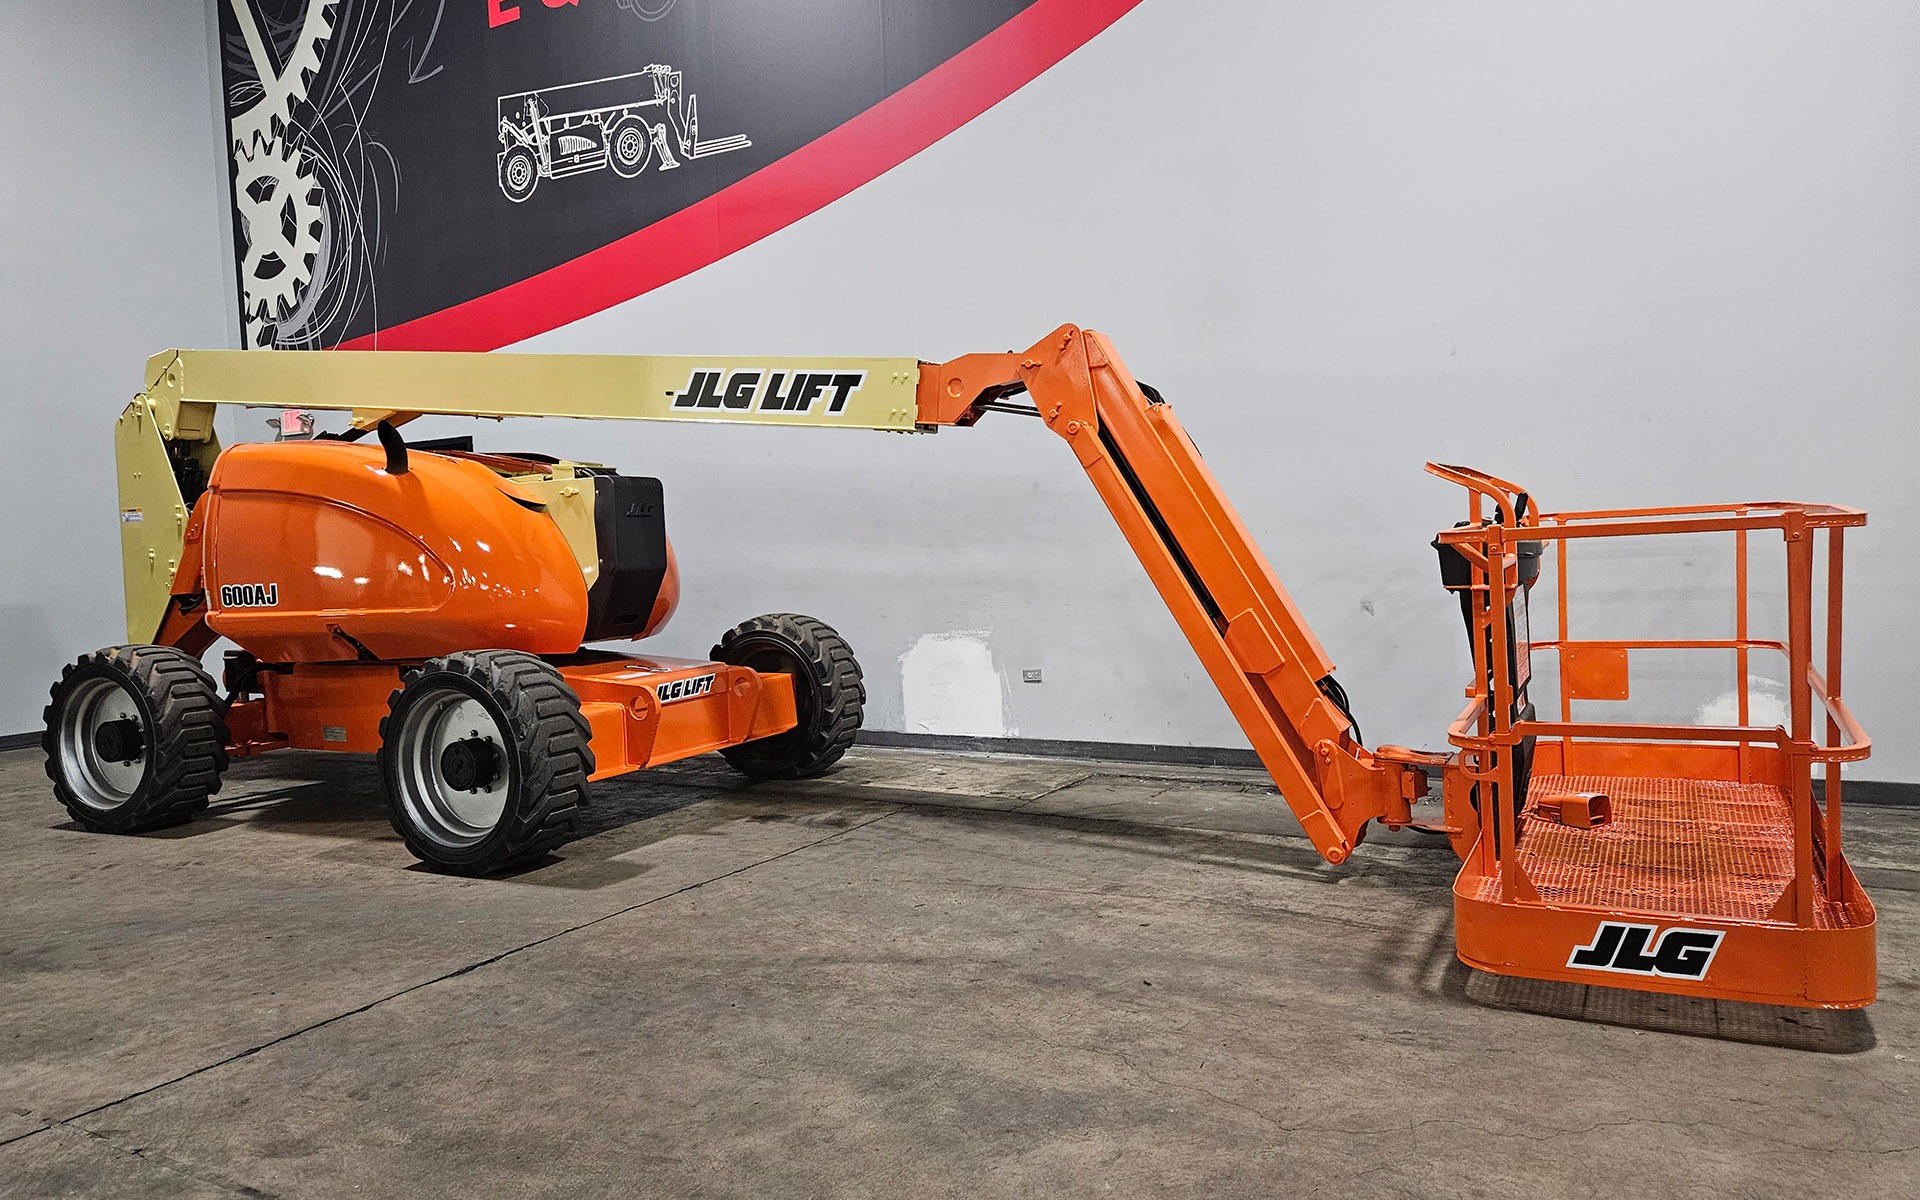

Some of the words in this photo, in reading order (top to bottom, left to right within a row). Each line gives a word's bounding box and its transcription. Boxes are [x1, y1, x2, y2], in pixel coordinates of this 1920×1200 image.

[674, 371, 761, 409] JLG
[760, 373, 863, 412] LIFT
[221, 584, 277, 606] 600AJ
[683, 674, 715, 697] LIFT
[1572, 924, 1720, 977] JLG
